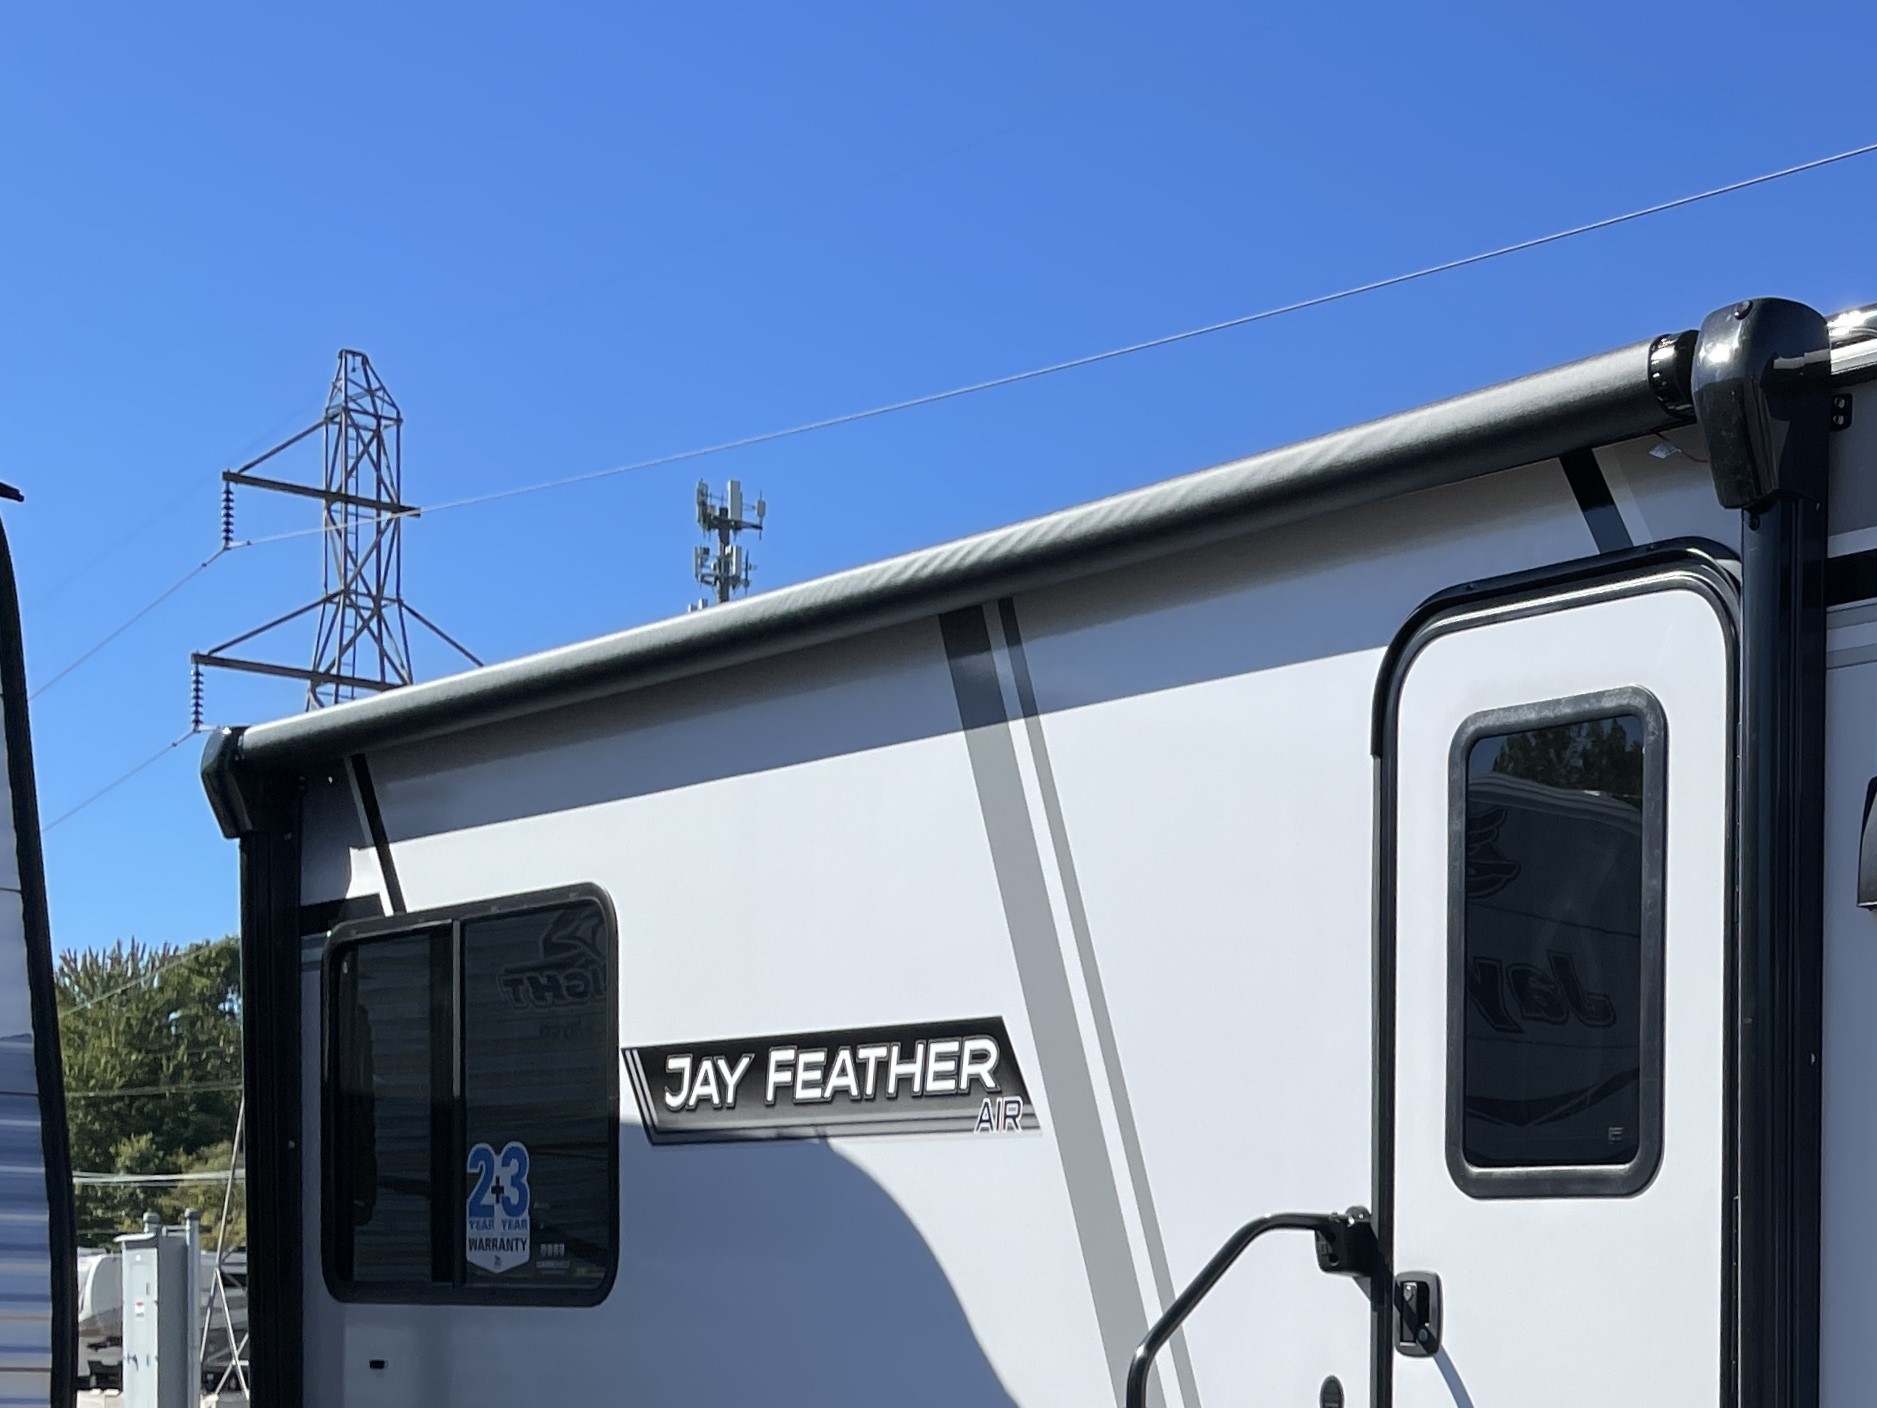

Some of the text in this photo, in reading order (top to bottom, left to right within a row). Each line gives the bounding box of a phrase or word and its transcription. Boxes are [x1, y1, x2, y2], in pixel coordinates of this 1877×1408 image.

[664, 1035, 1001, 1111] JAY FEATHER
[973, 1097, 1023, 1134] AIR
[469, 1218, 528, 1231] YEAR YEAR
[468, 1238, 528, 1251] WARRANTY
